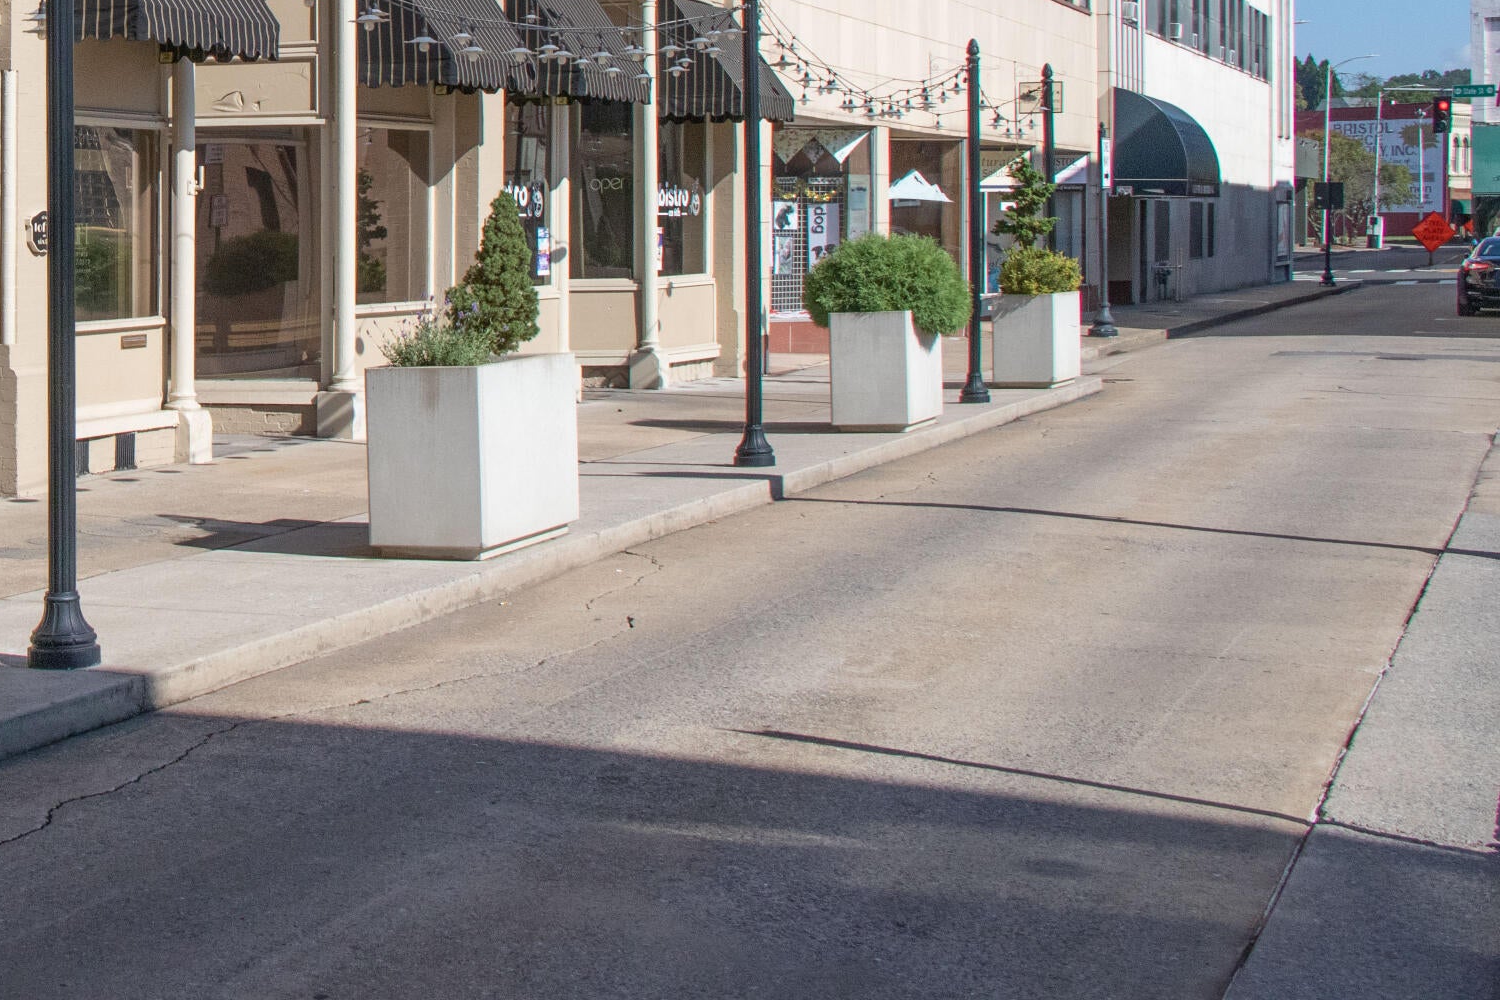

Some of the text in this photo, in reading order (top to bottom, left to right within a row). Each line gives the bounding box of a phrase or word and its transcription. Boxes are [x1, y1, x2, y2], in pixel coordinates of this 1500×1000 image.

[658, 181, 689, 207] bistro
[34, 222, 48, 233] lof
[811, 206, 827, 234] dog
